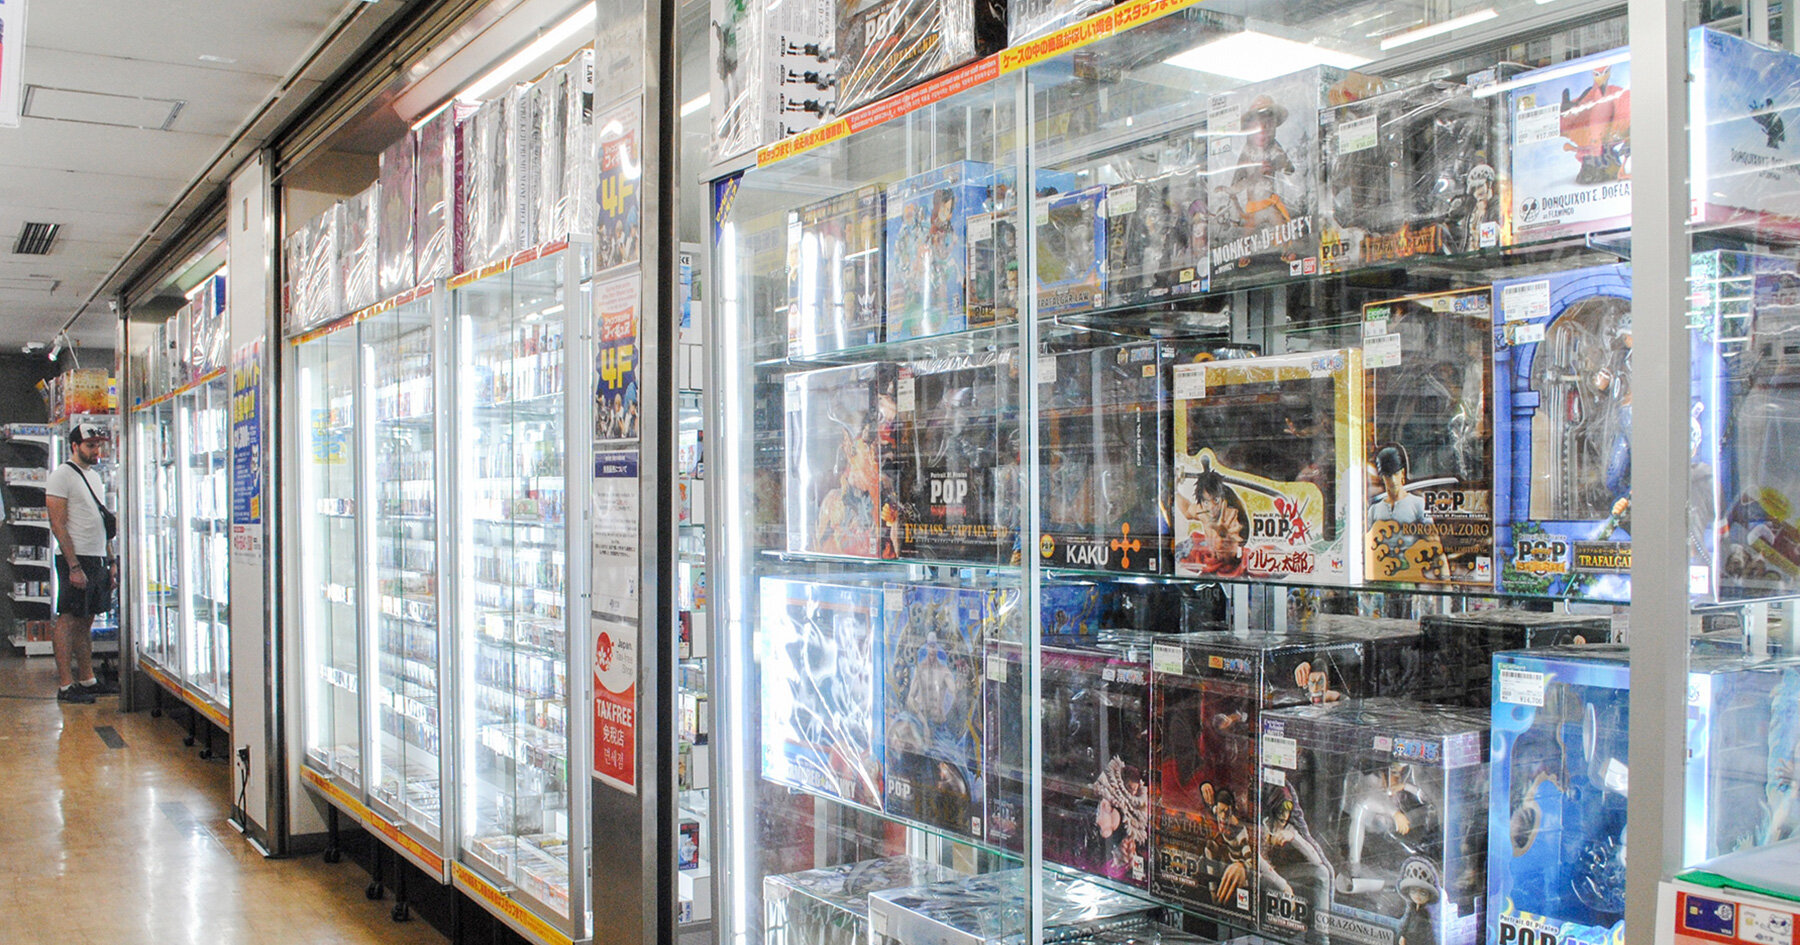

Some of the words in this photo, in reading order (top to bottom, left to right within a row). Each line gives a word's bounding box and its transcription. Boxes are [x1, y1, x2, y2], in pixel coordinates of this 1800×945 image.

[602, 172, 634, 218] 4F
[601, 344, 633, 390] 4F
[930, 479, 968, 504] P.O.P
[1424, 491, 1464, 511] P.O.P
[1253, 518, 1290, 537] P.O.P
[1402, 523, 1489, 536] RORONOA.ZORO
[1066, 544, 1109, 566] KAKU
[603, 723, 625, 748] 免税店
[604, 748, 624, 771] 면세점
[1267, 895, 1308, 922] P.O.P
